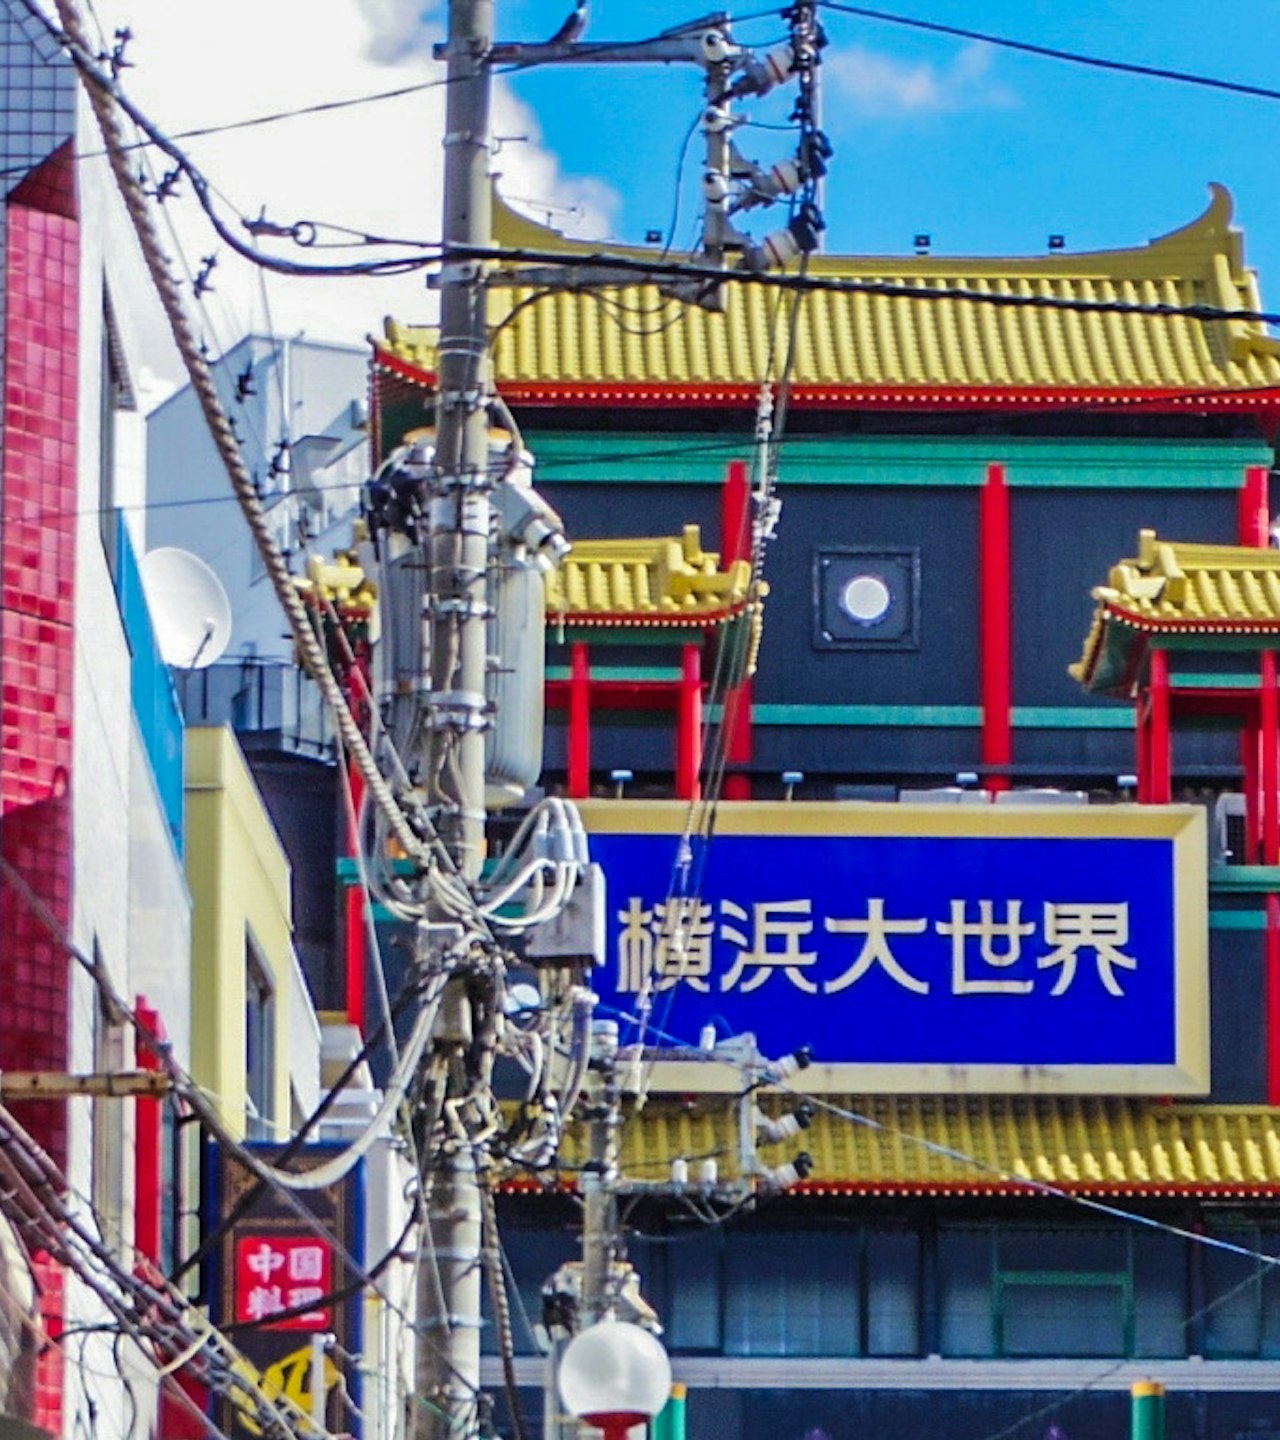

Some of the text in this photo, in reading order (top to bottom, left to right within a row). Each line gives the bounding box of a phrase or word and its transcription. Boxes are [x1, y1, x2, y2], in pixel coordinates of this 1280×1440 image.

[616, 897, 1137, 996] 横浜大世界
[247, 1243, 324, 1283] 中国
